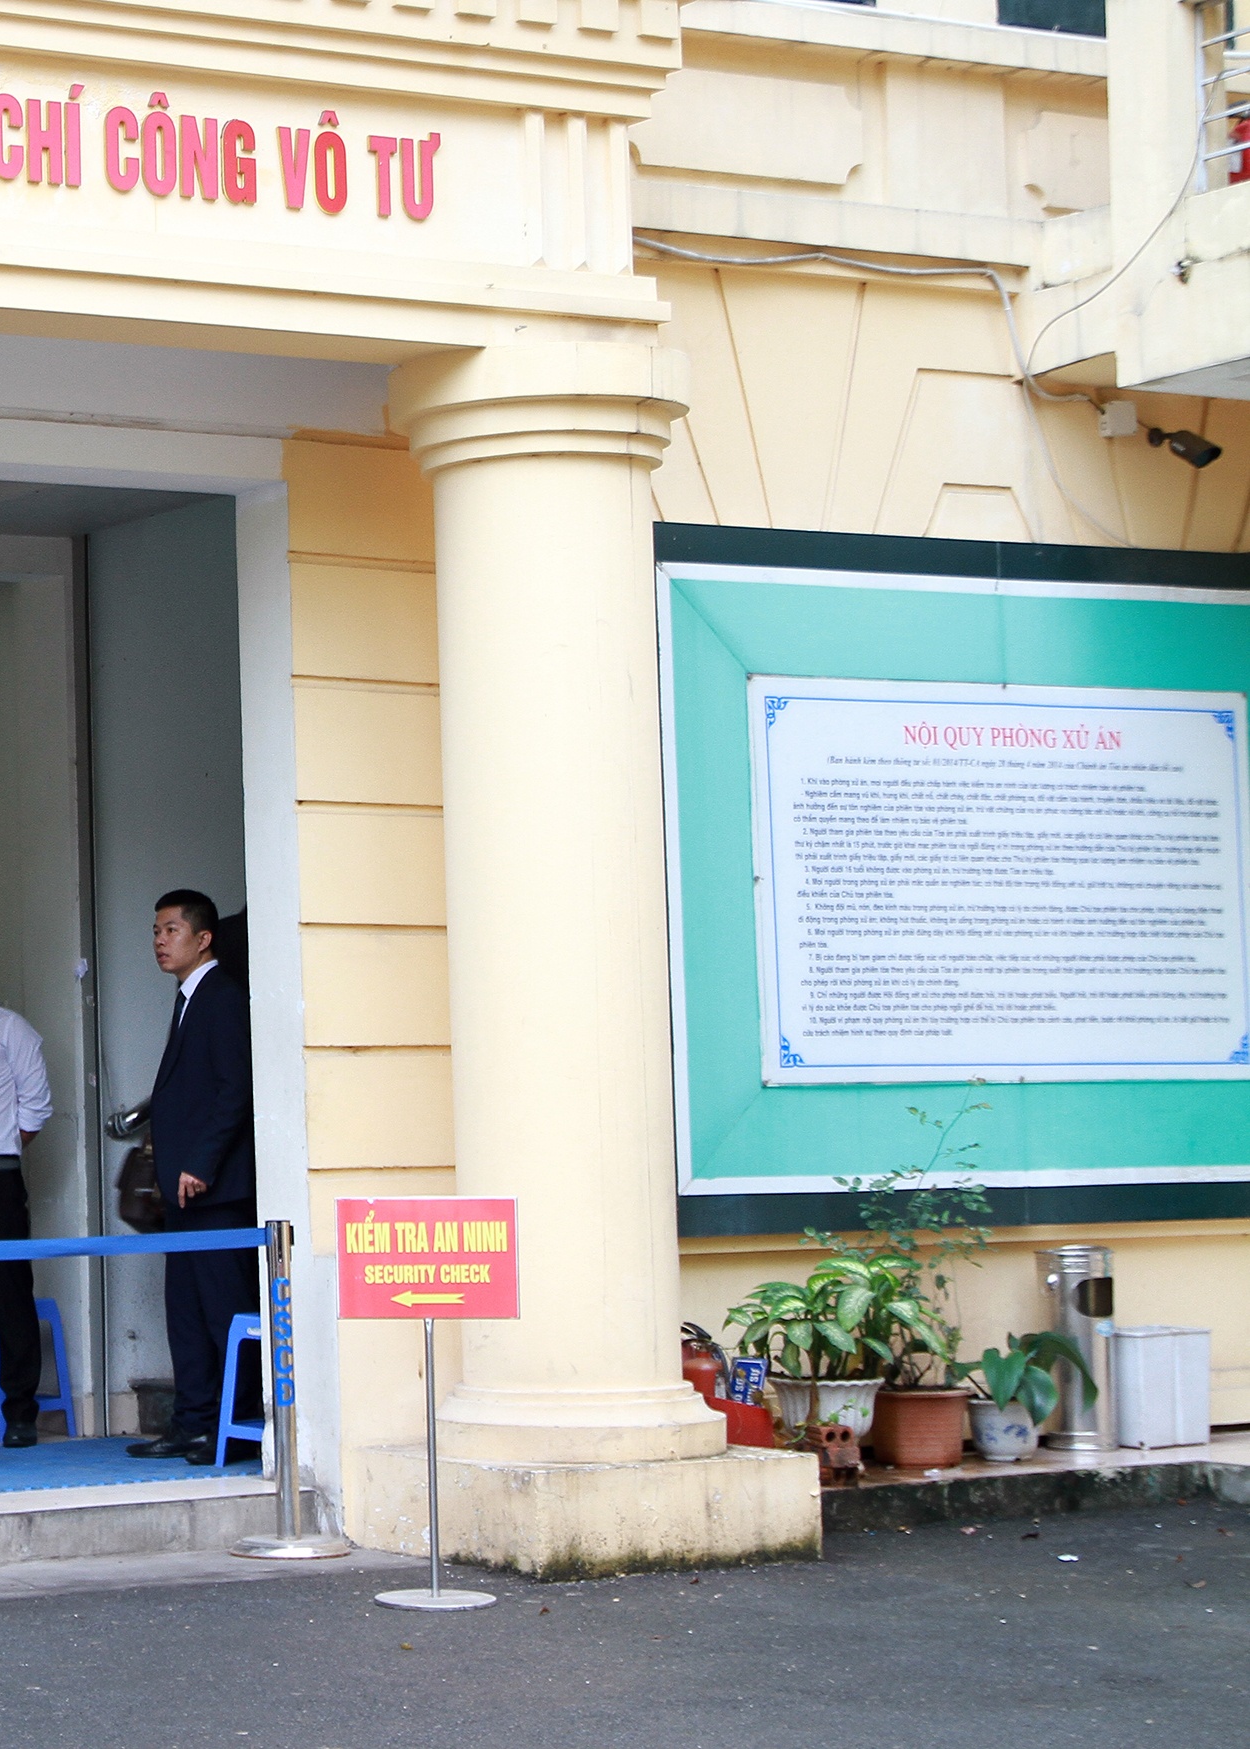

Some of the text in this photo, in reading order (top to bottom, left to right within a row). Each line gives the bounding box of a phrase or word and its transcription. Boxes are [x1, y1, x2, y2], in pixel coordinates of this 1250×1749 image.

[104, 92, 258, 206] CÔNG
[277, 110, 349, 216] VÔ
[366, 132, 442, 222] TƯ
[903, 721, 1123, 750] NỘI QUY PHÒNG XỬ ÁN
[345, 1209, 509, 1254] KIỂM TRA AN NINH
[364, 1264, 491, 1284] SECURITY CHECK
